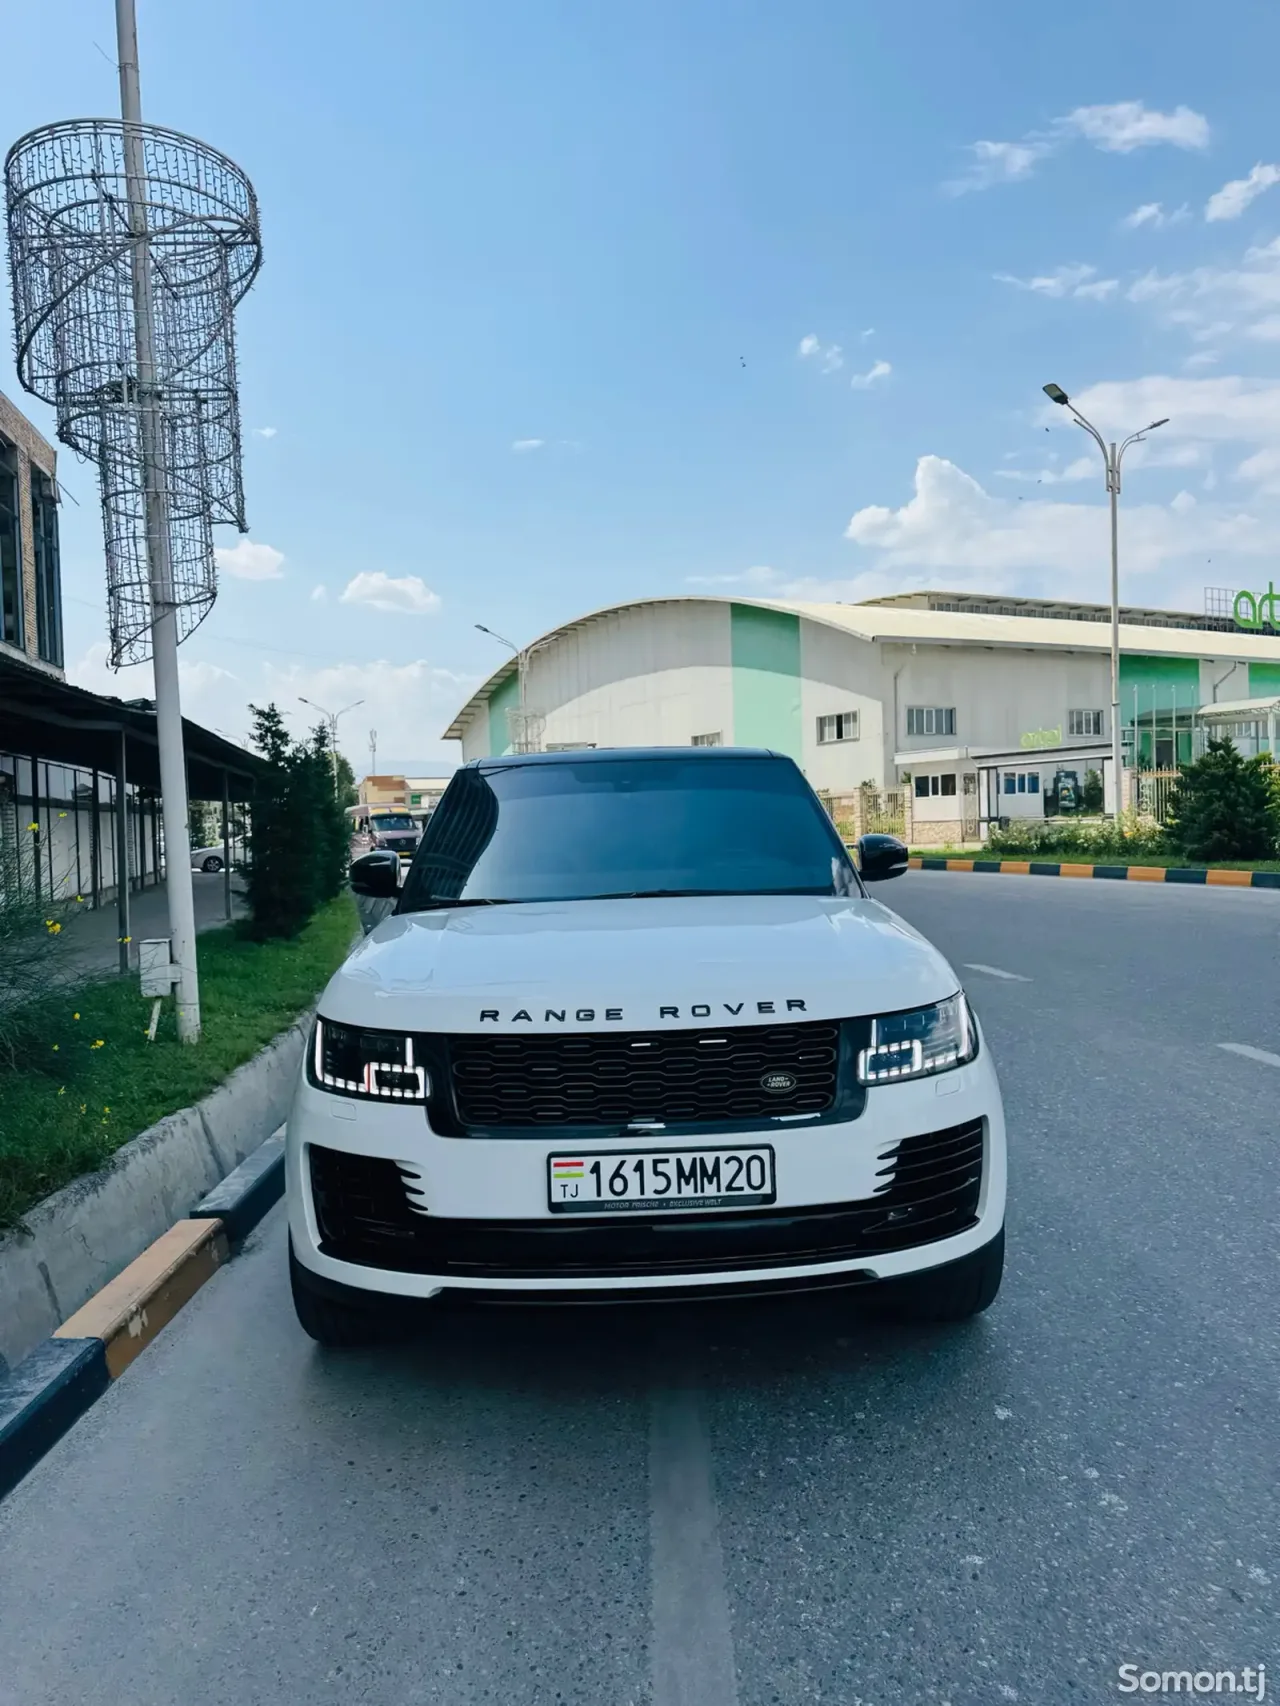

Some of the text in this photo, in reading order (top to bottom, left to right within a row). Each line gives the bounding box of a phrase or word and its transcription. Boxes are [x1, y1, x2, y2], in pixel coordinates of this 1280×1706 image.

[480, 999, 807, 1022] RANGE ROVER
[589, 1154, 766, 1198] 1615MM20
[560, 1184, 579, 1198] TJ
